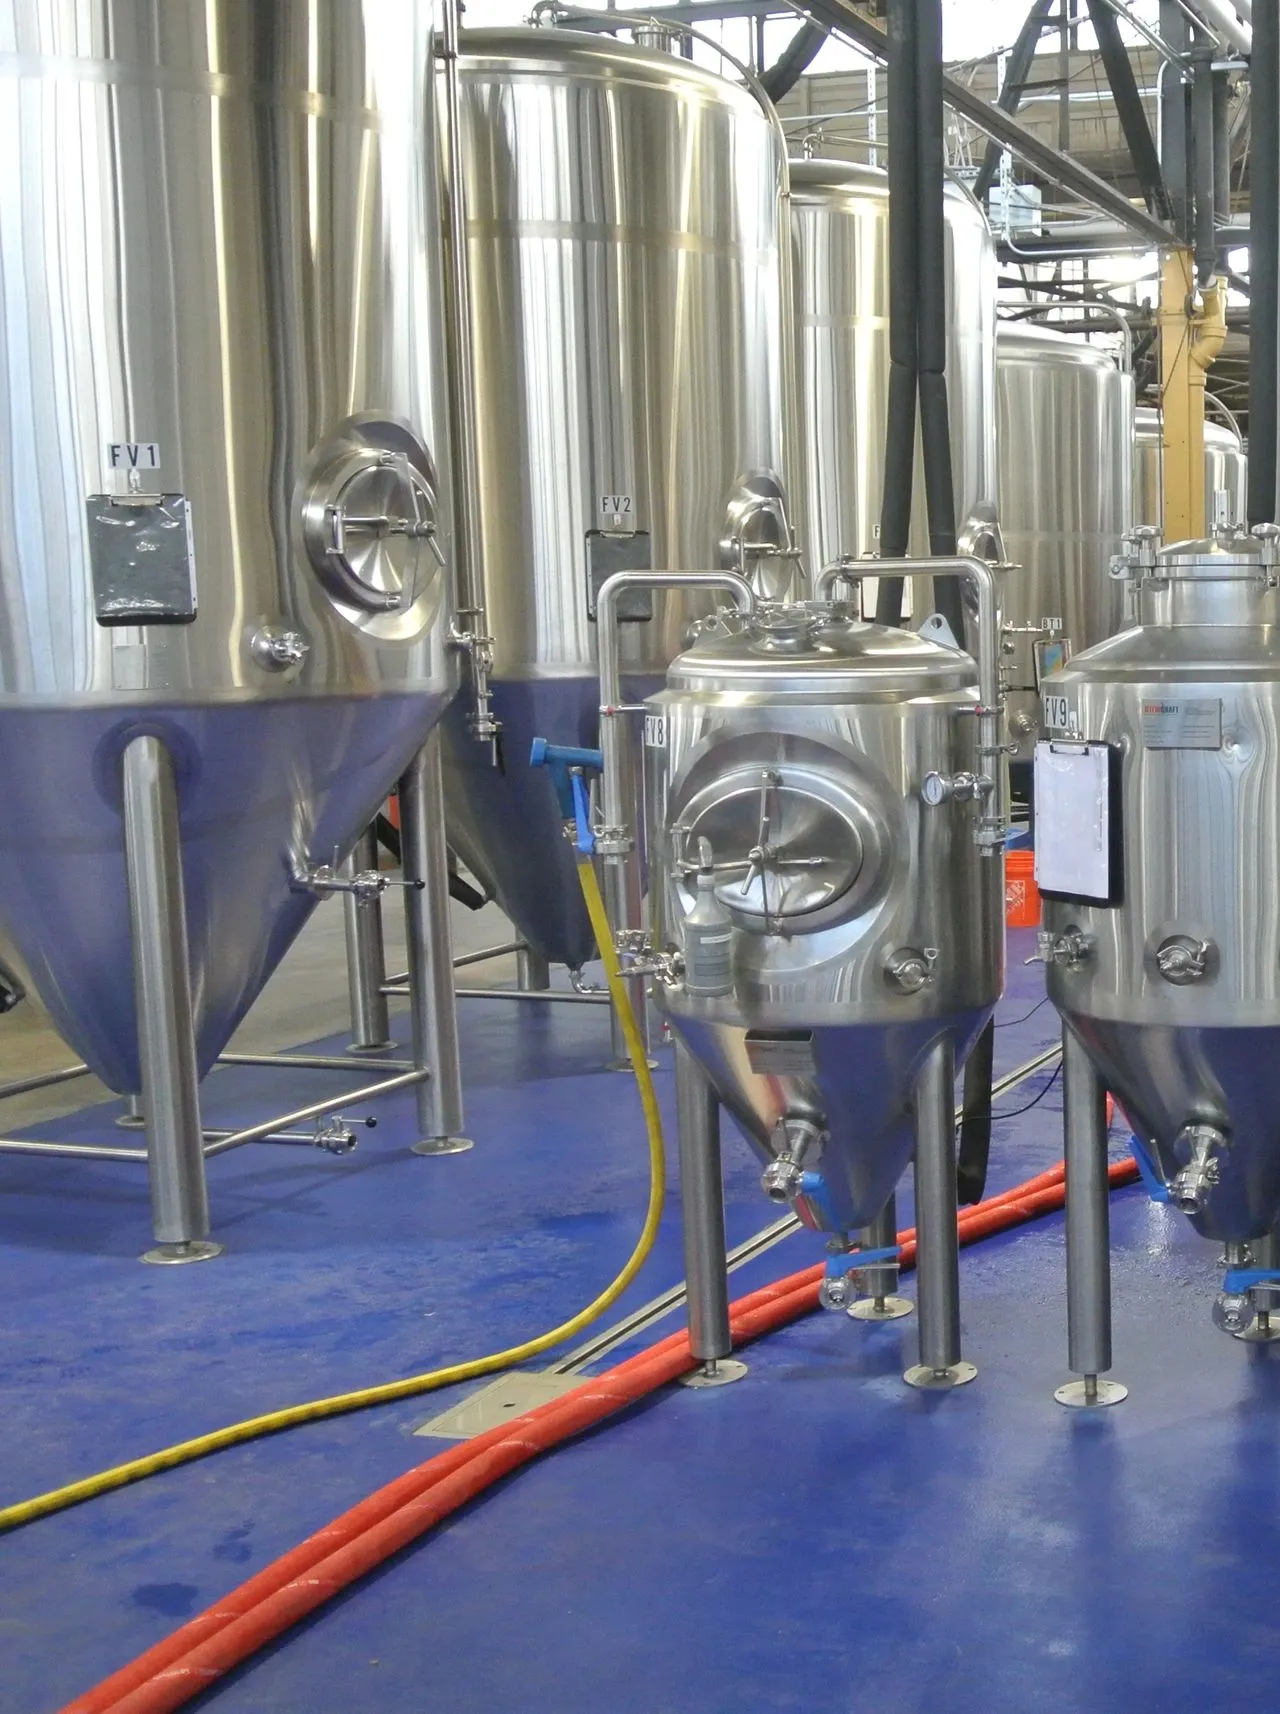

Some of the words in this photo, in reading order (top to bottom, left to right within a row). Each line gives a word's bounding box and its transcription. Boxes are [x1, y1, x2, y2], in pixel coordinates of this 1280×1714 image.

[110, 444, 155, 467] FV1
[602, 496, 631, 513] FV2
[1045, 697, 1067, 727] FV9
[645, 716, 664, 745] FV8
